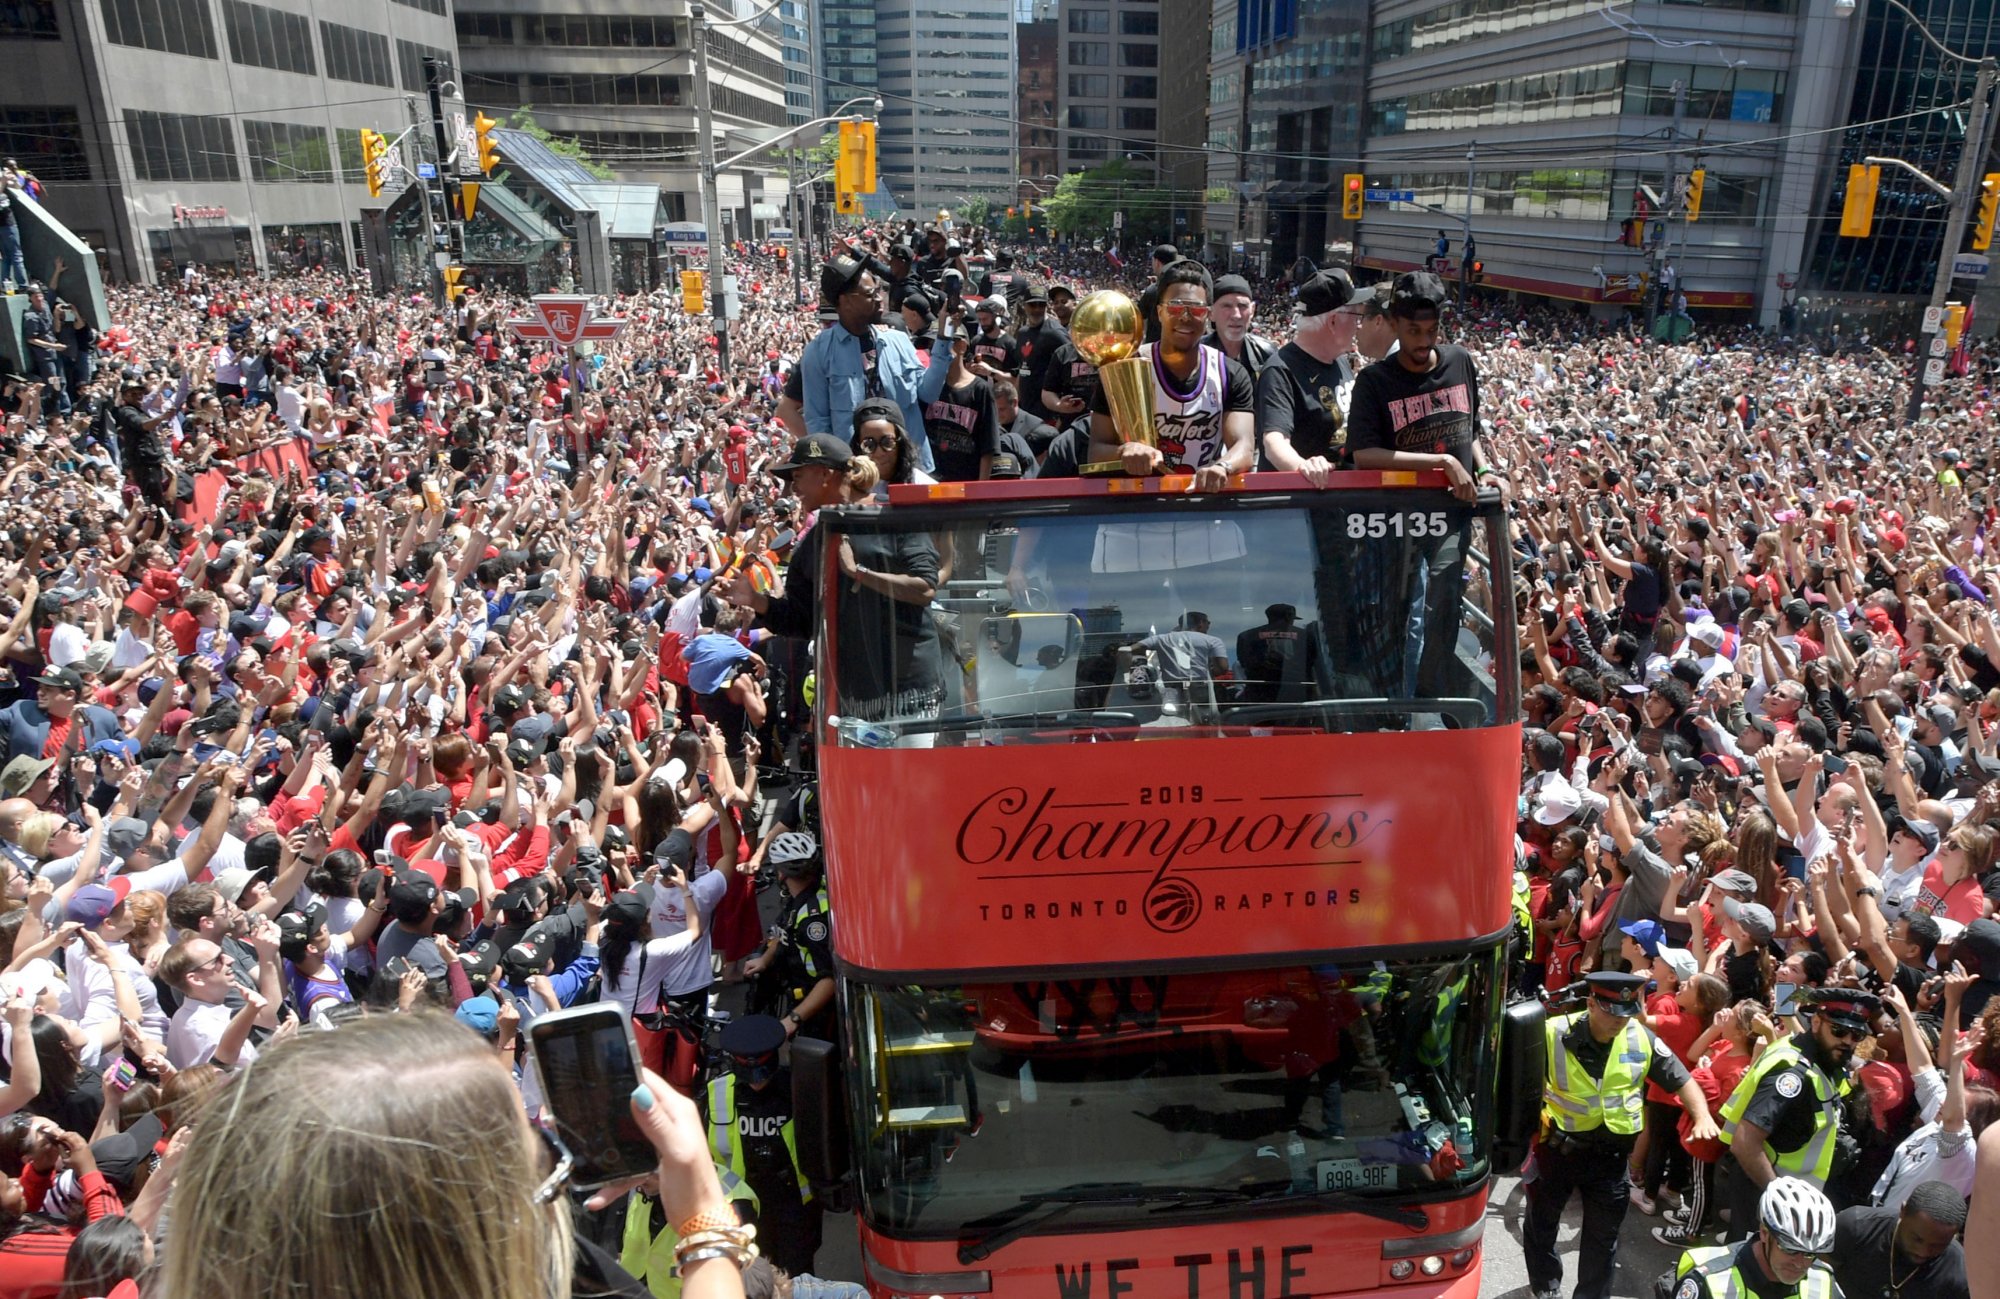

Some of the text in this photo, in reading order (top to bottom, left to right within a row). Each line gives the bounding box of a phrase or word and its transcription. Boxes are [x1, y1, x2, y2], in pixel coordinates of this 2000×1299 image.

[672, 232, 688, 242] King
[1957, 263, 1971, 273] King
[1346, 511, 1448, 539] 85135
[1139, 785, 1203, 805] 2019
[955, 786, 1393, 882] Champions
[979, 887, 1362, 921] TORONTO RAPTORS
[738, 1115, 787, 1137] OLICE
[1173, 1244, 1313, 1299] THE
